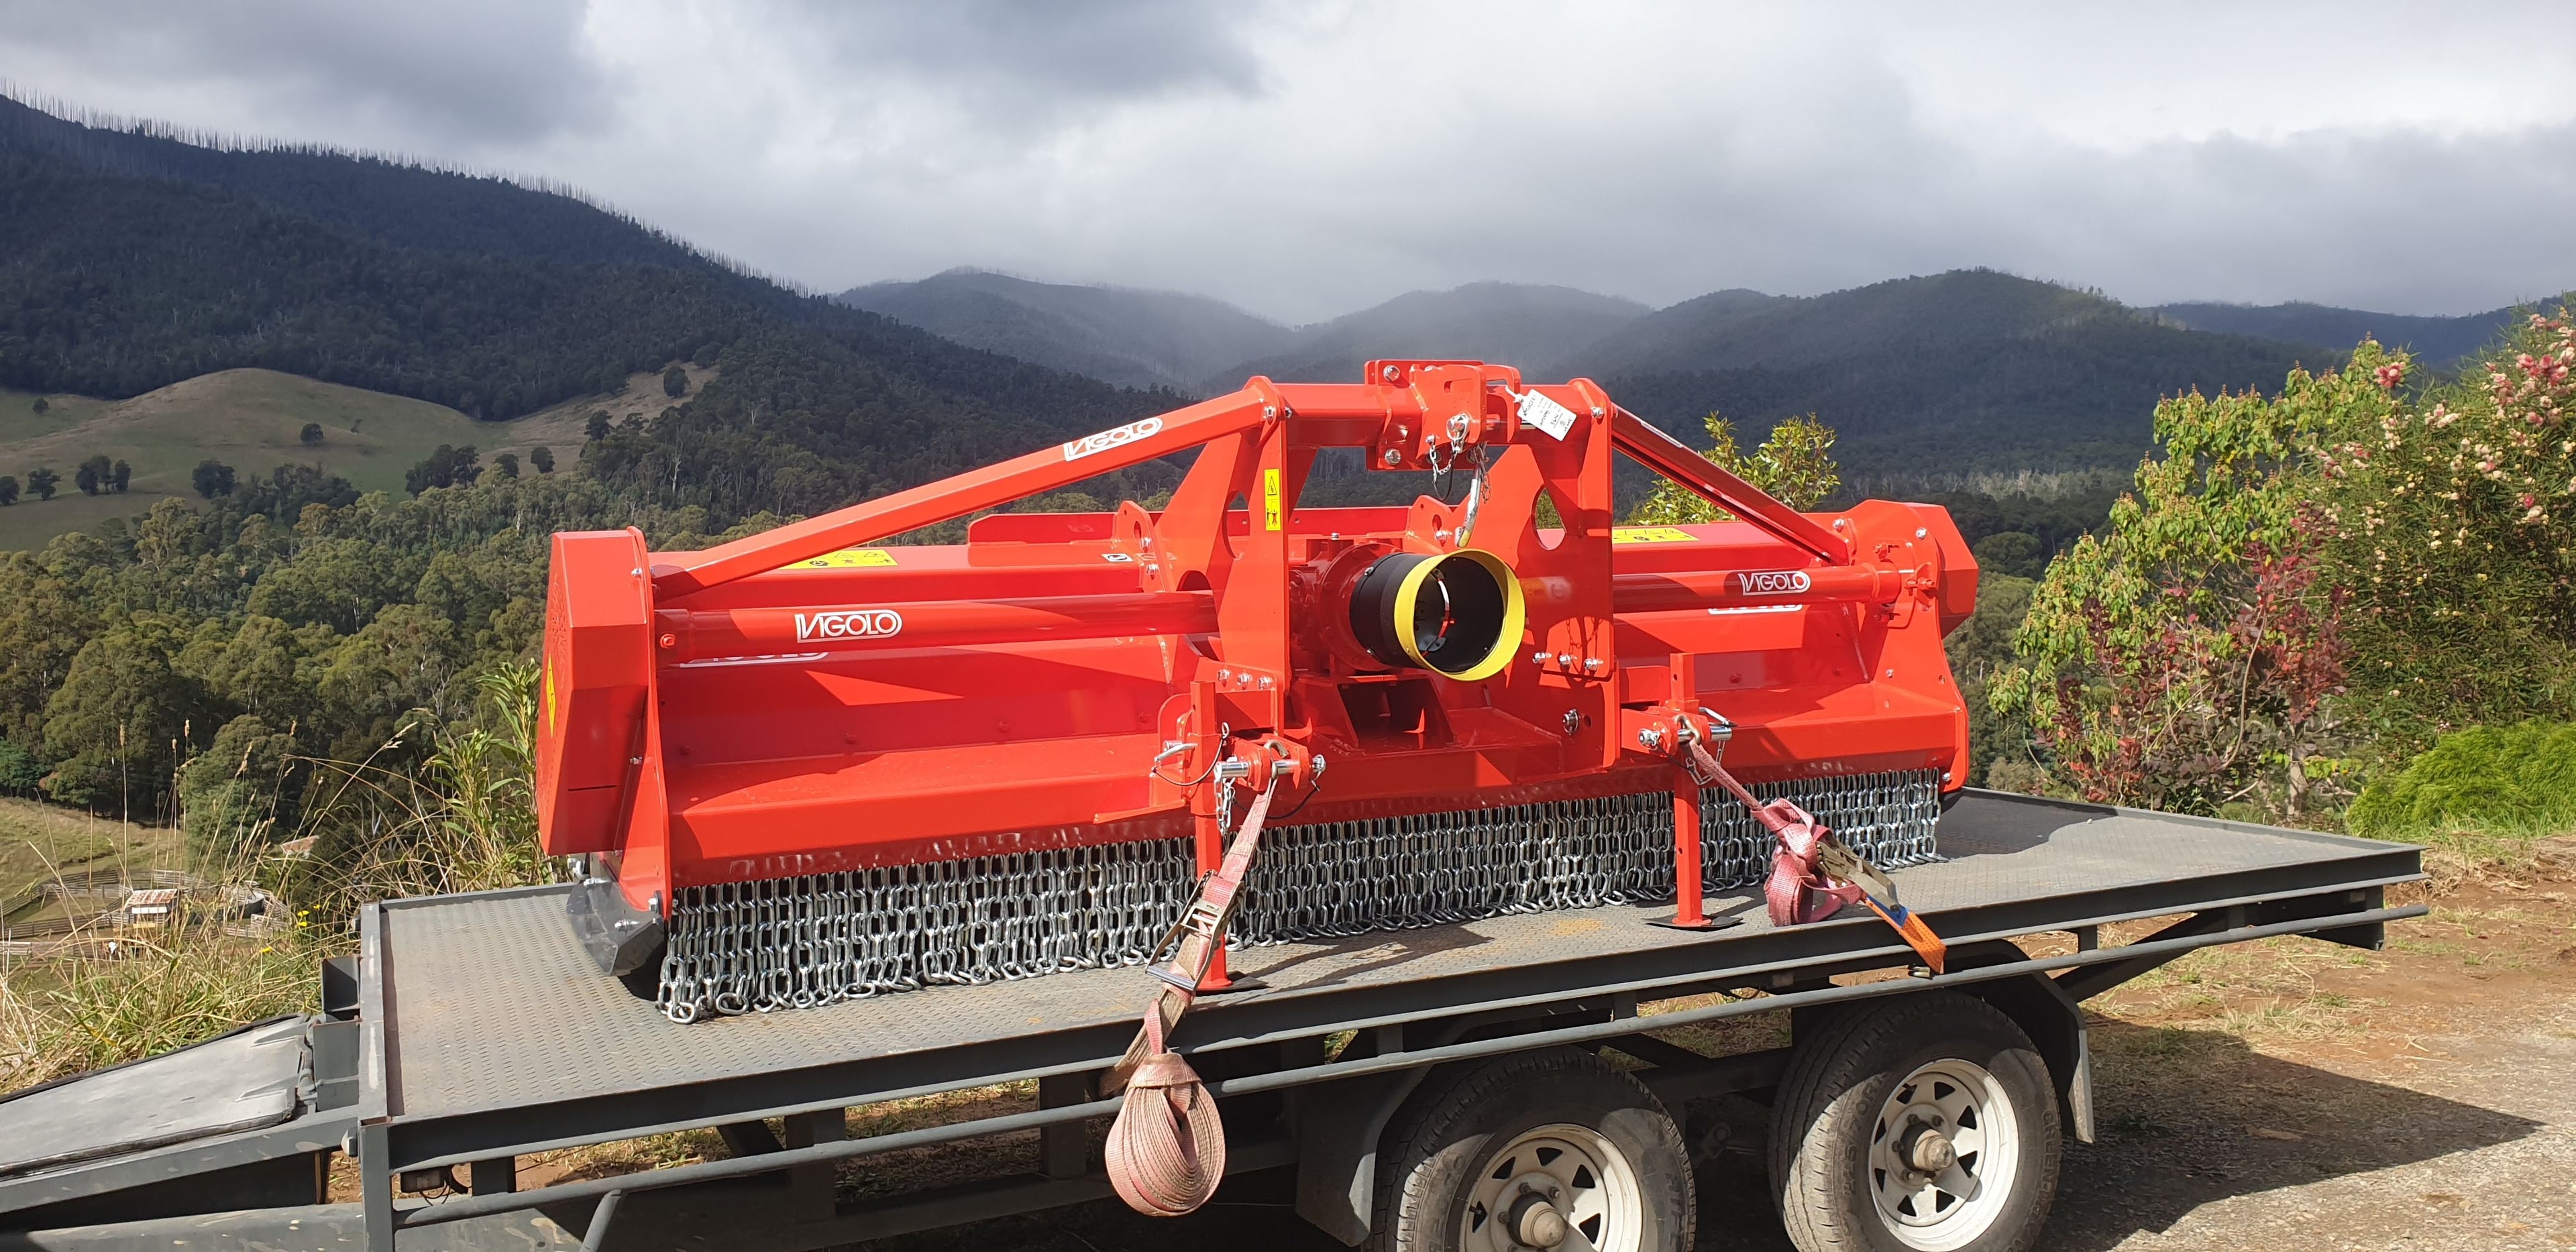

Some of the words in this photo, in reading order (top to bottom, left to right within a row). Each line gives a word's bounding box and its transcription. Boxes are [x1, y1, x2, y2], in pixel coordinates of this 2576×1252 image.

[1064, 417, 1163, 461] VIGOLO
[1737, 571, 1811, 595] VIGOLO
[794, 610, 902, 643] VIGOLO
